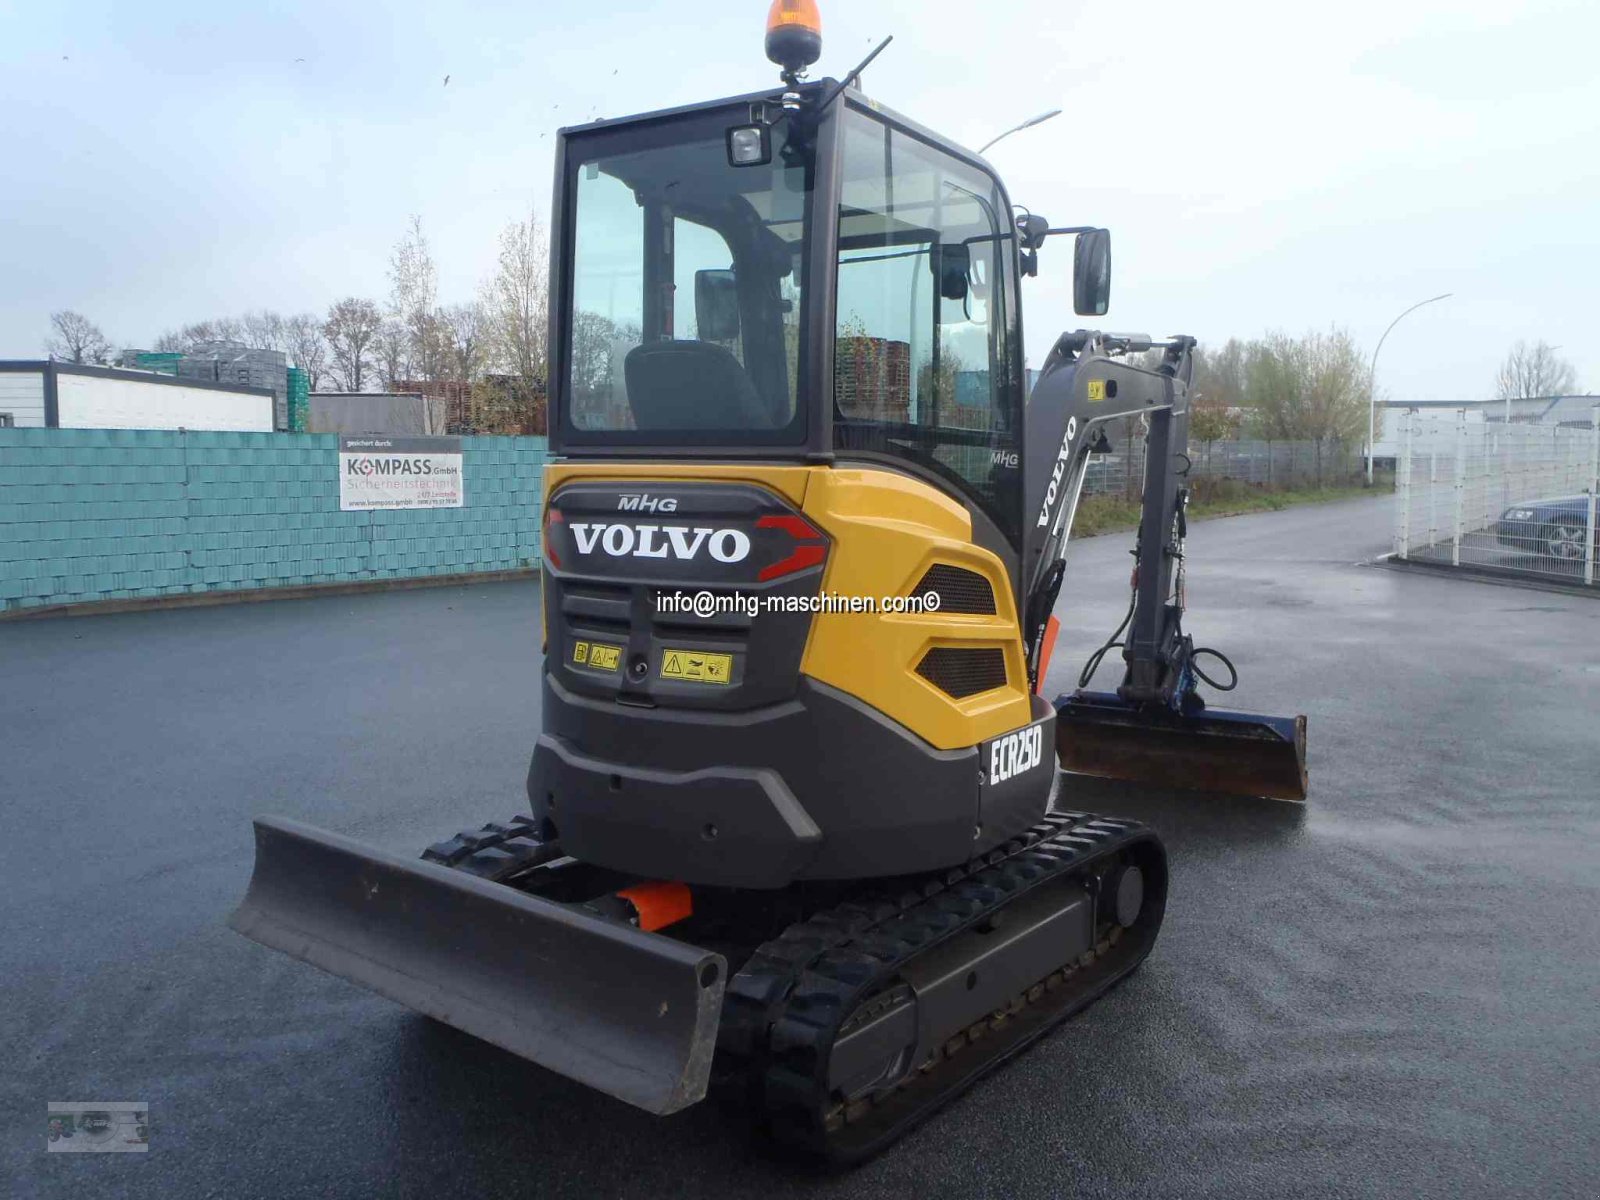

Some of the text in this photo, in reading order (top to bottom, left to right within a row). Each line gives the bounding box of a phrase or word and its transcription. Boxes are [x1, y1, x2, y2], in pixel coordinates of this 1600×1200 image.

[990, 450, 1019, 468] MHG
[1037, 416, 1076, 528] VOLVO
[347, 479, 457, 490] Sicherheitstechnik
[617, 494, 678, 513] MHG
[569, 523, 751, 563] VOLVO
[990, 724, 1042, 786] ECR25D
